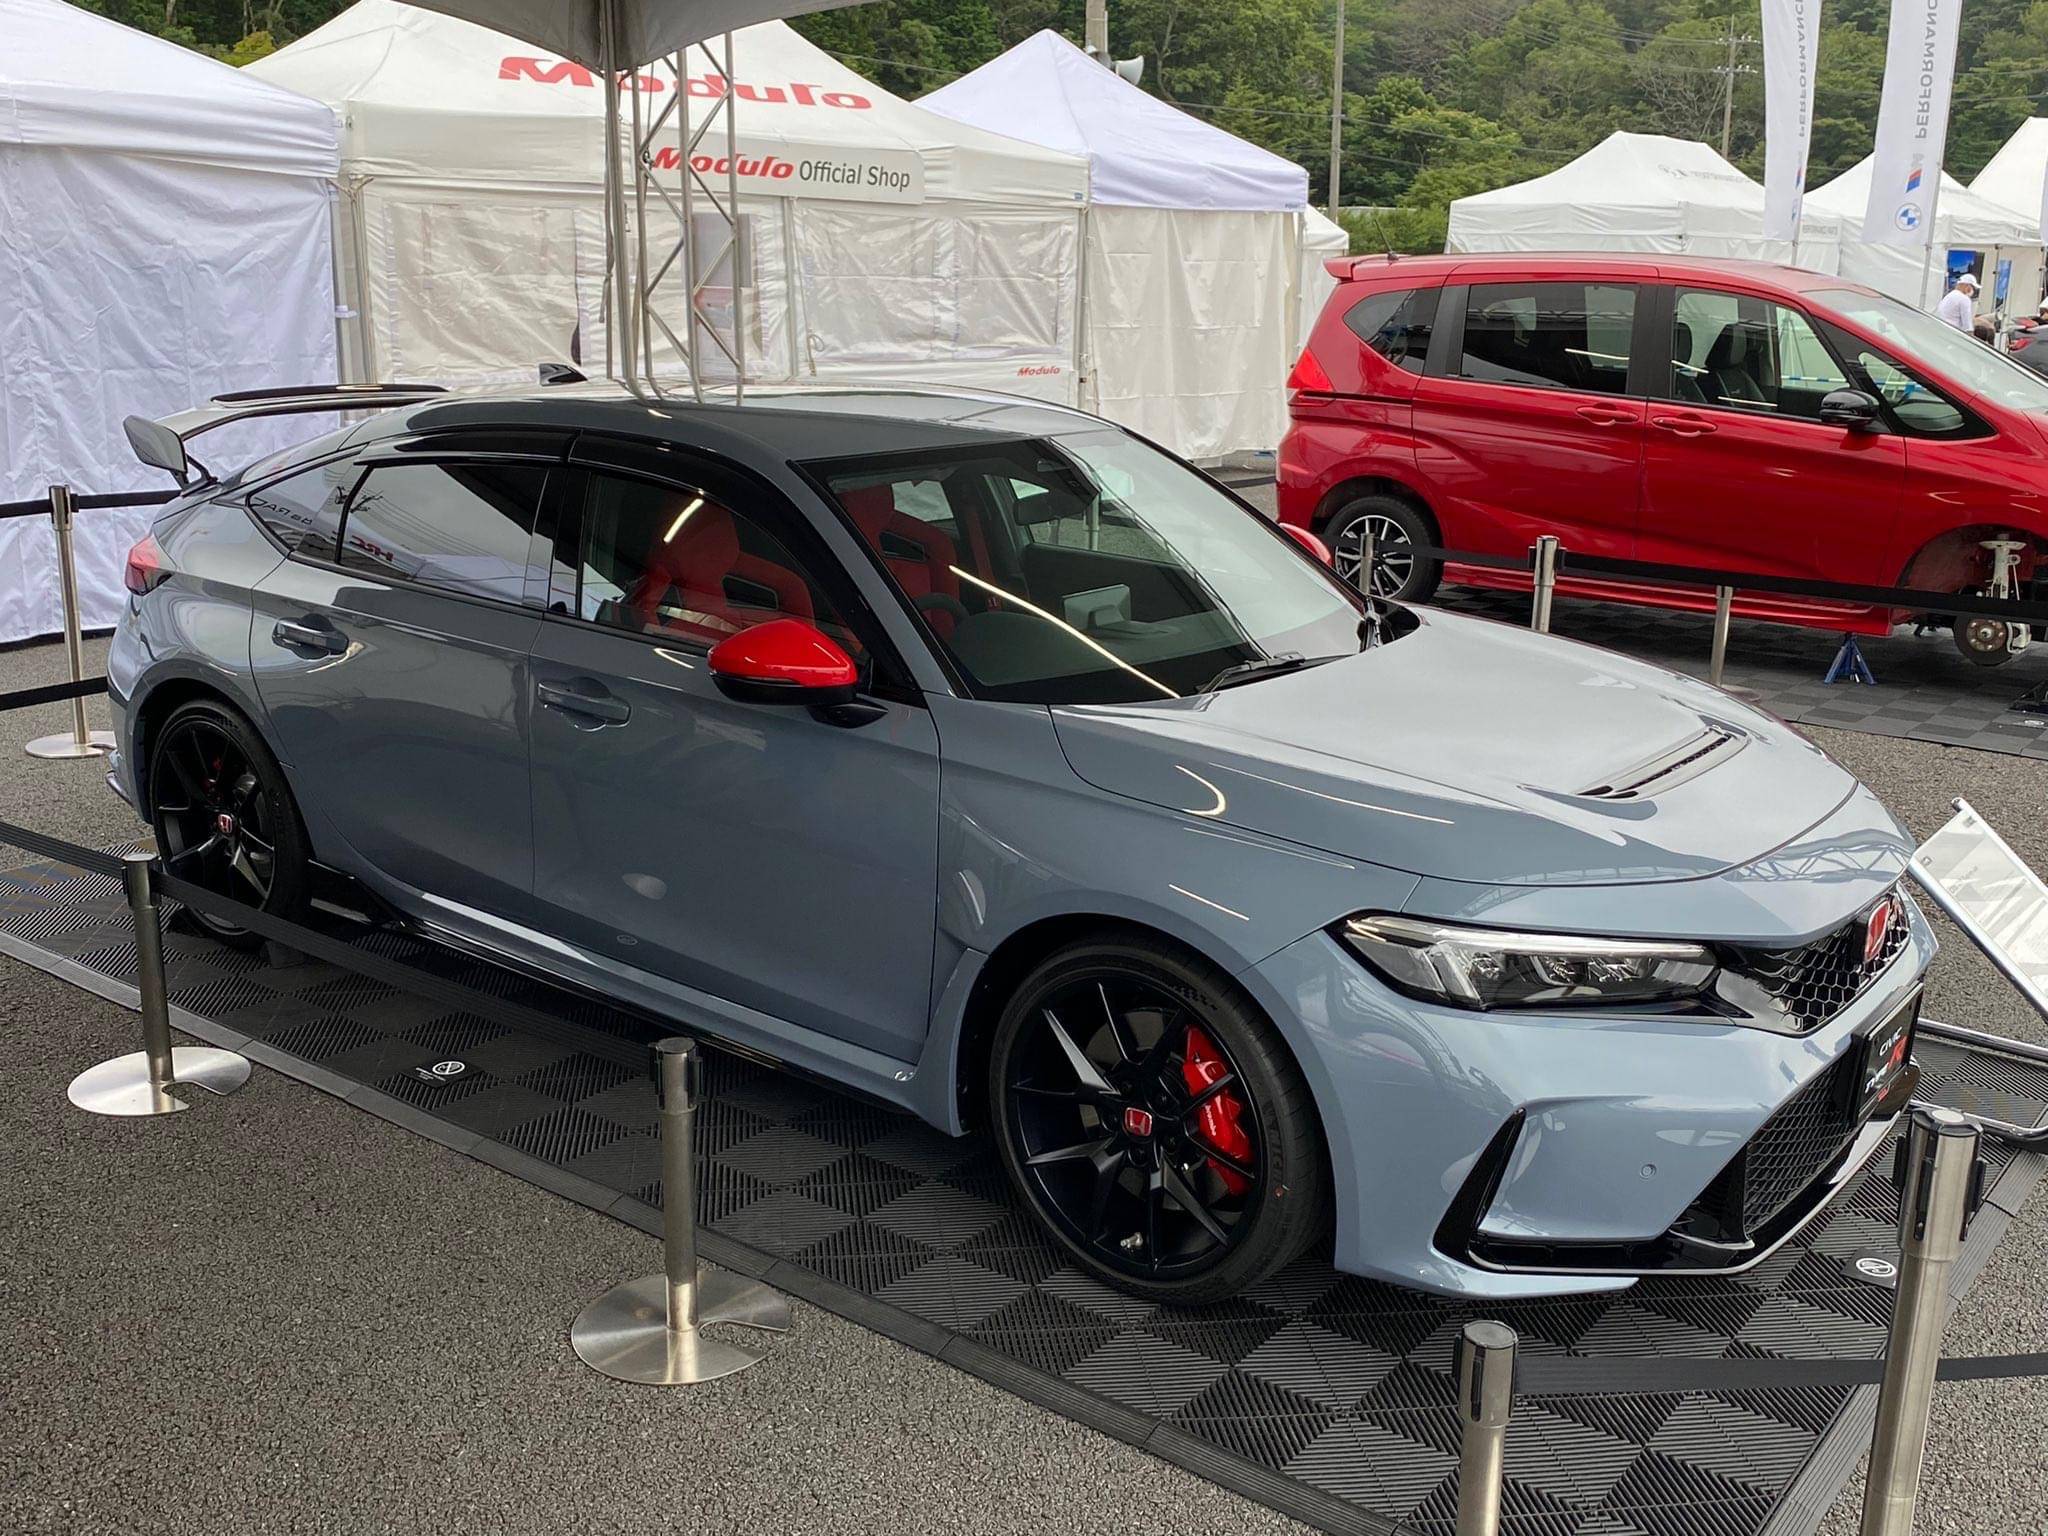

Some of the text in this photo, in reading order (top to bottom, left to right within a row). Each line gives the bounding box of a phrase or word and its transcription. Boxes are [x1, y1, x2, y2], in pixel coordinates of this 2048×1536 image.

[498, 56, 872, 110] Modulo
[653, 147, 910, 192] Modulo Official Shop
[1017, 365, 1061, 376] Modulo
